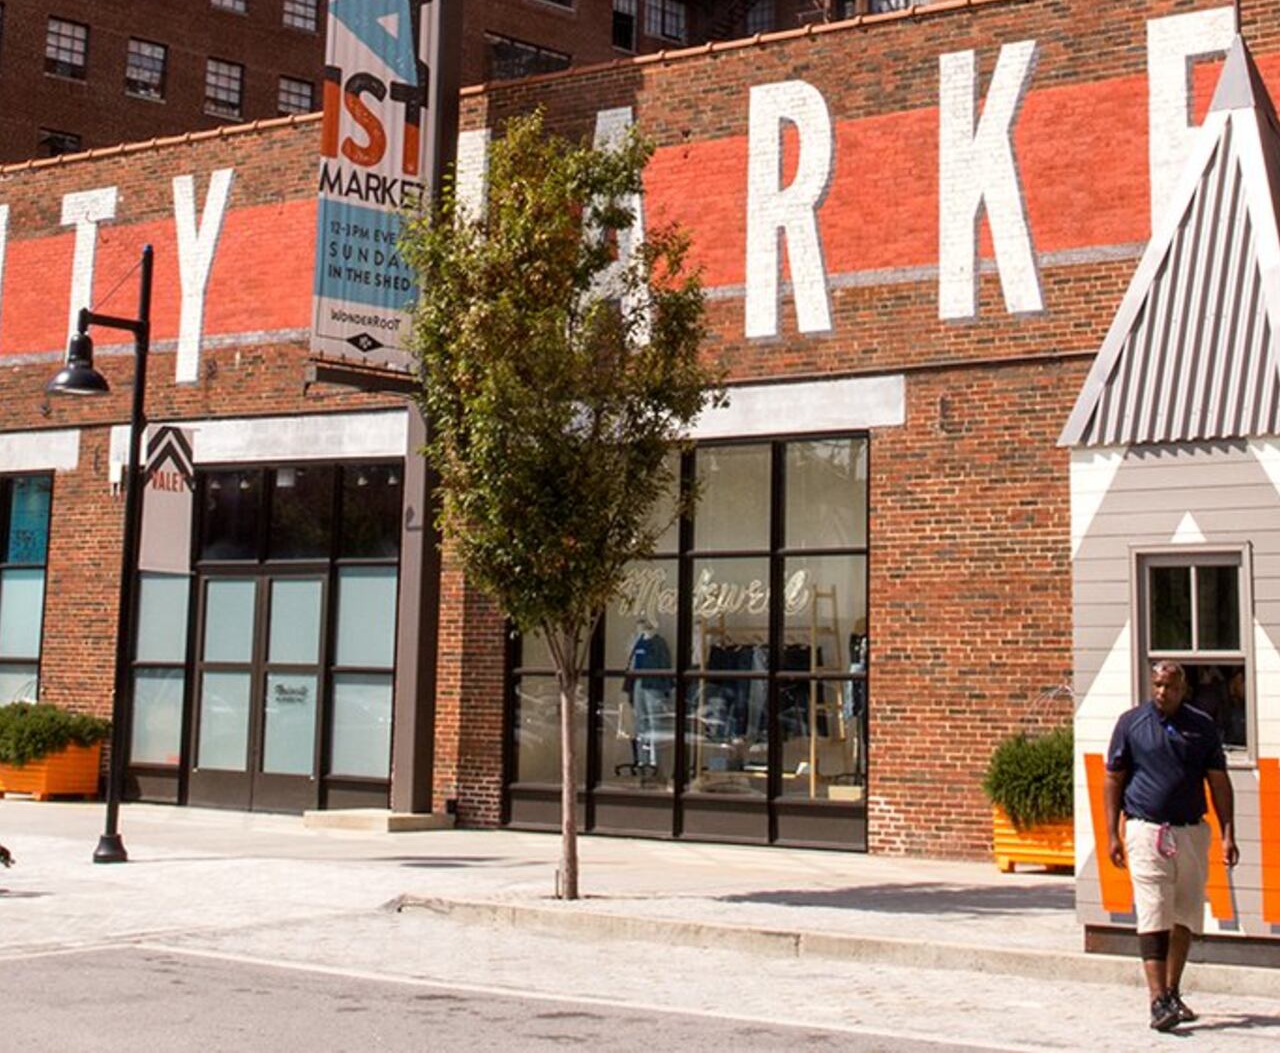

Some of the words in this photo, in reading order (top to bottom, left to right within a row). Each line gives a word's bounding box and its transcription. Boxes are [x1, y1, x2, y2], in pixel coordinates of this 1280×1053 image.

[319, 163, 425, 211] MARKET
[328, 263, 342, 279] IN
[346, 267, 371, 285] THE
[374, 272, 412, 291] SHED
[152, 470, 184, 493] VALET
[615, 566, 811, 629] Madewel
